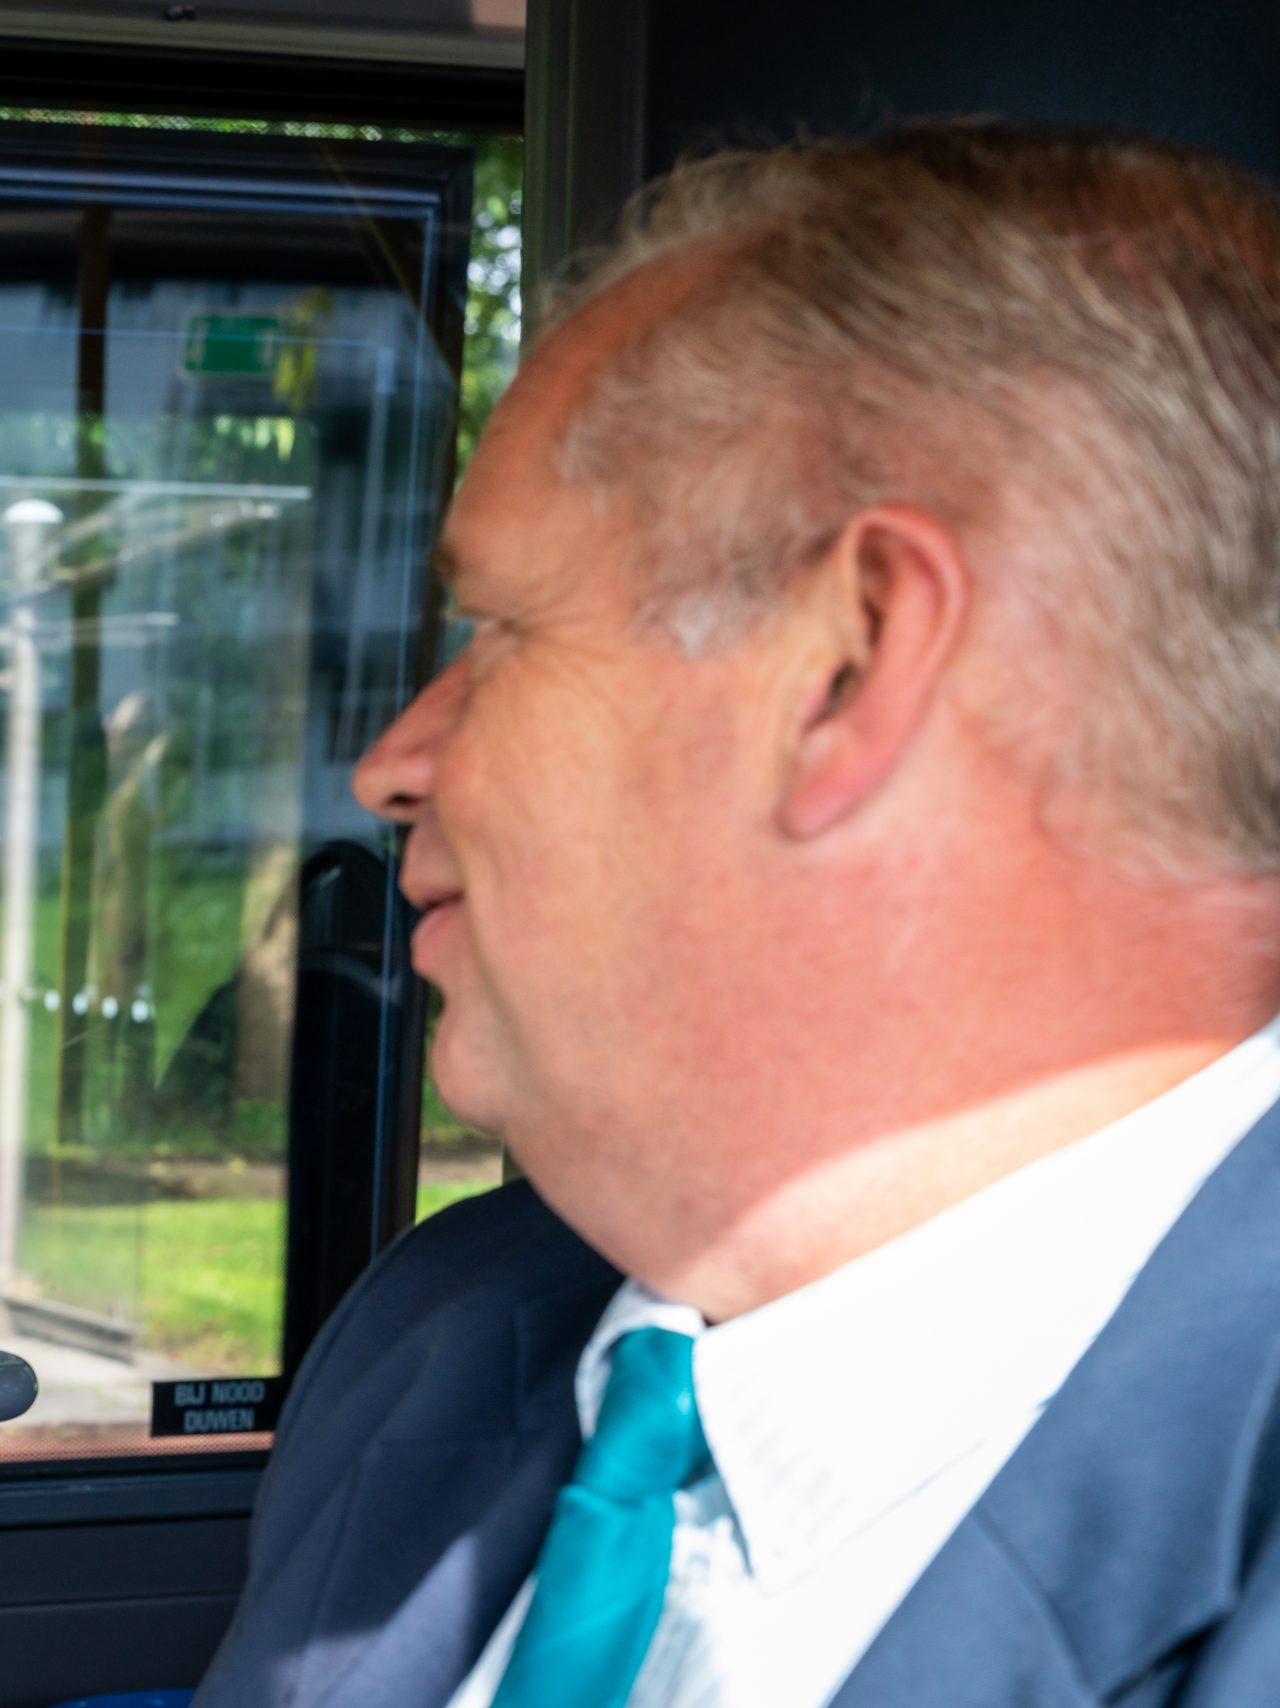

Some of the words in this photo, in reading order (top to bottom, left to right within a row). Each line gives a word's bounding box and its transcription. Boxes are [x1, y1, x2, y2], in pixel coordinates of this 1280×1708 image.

[175, 1383, 205, 1407] BIJ
[211, 1381, 265, 1406] NOOD
[184, 1408, 255, 1433] DUWEN
